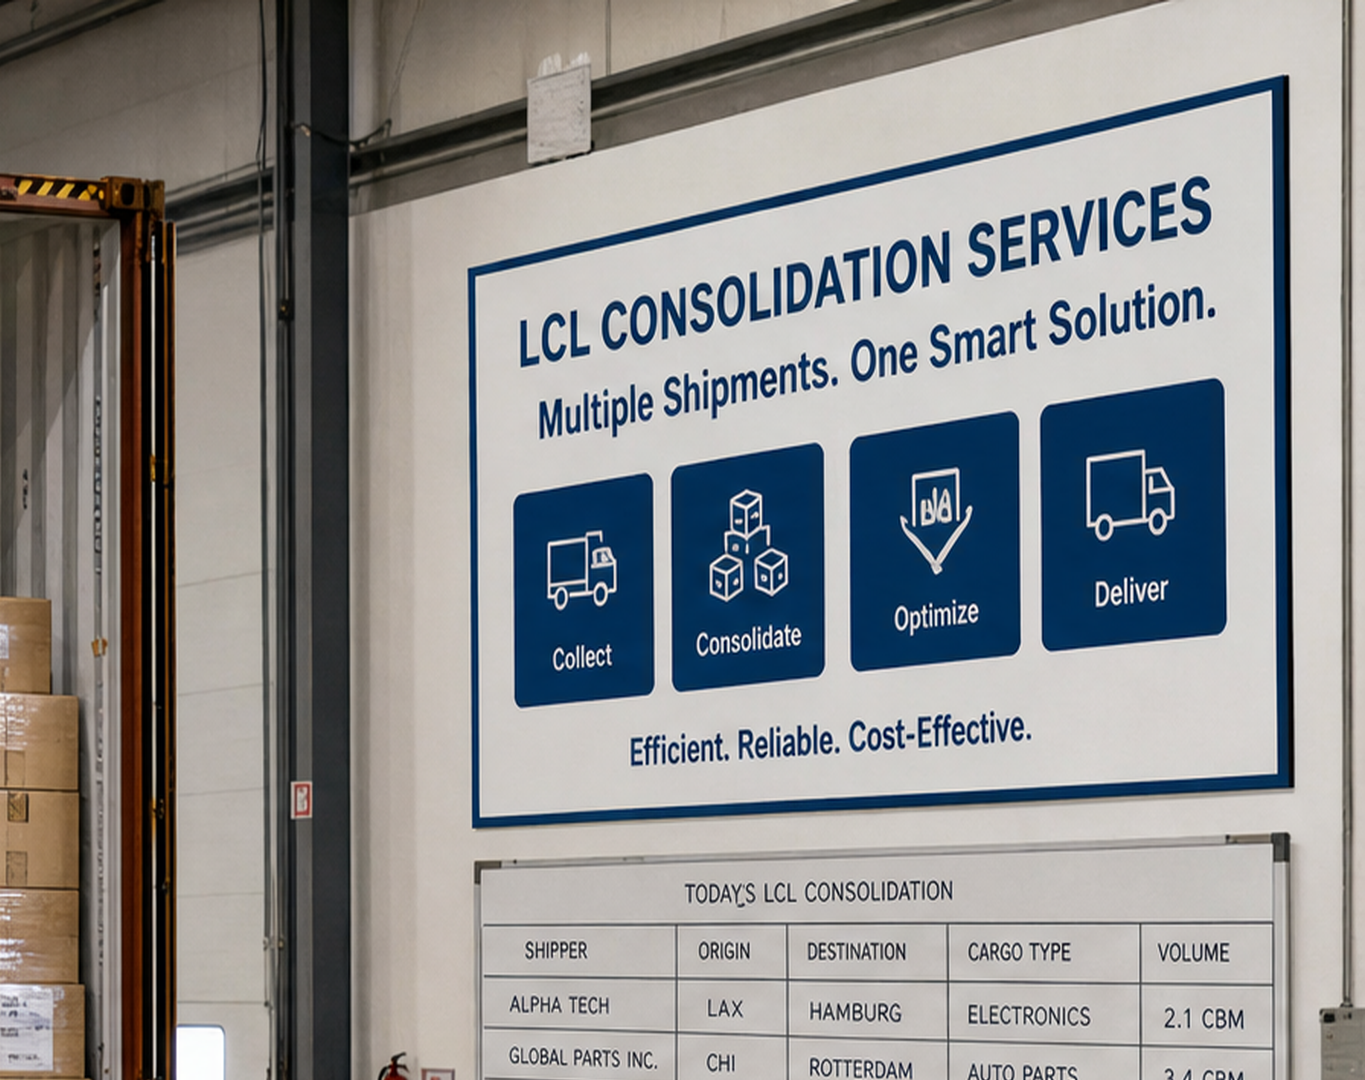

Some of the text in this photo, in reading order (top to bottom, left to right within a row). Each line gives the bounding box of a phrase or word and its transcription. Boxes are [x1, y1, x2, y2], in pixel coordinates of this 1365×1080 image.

[519, 175, 1212, 368] LCL CONSOLIDATION SERVICES
[539, 283, 1216, 440] Multiple Shipments. One Smart Solution.
[1095, 576, 1169, 608] Deliver
[894, 599, 979, 637] Optimize
[696, 624, 802, 657] Consolidate
[552, 643, 613, 671] Collect
[630, 710, 1032, 767] Efficient. Reliable. Cost-Effective.
[684, 879, 953, 909] TODAY'S LCL CONSOLIDATION
[524, 940, 588, 960] SHIPPER
[698, 941, 751, 961] ORIGIN
[807, 941, 906, 961] DESTINATION
[967, 941, 1072, 962] CARGO TYPE
[1157, 942, 1230, 963] VOLUME
[509, 995, 610, 1015] ALPHA TECH
[707, 998, 744, 1018] LAX
[809, 1001, 902, 1023] HAMBURG
[968, 1004, 1091, 1027] ELECTRONICS
[1164, 1007, 1244, 1030] 2.1 CBM
[508, 1046, 658, 1070] GLOBAL PARTS INC.
[706, 1052, 735, 1073] CHI
[809, 1057, 913, 1080] ROTTERDAM
